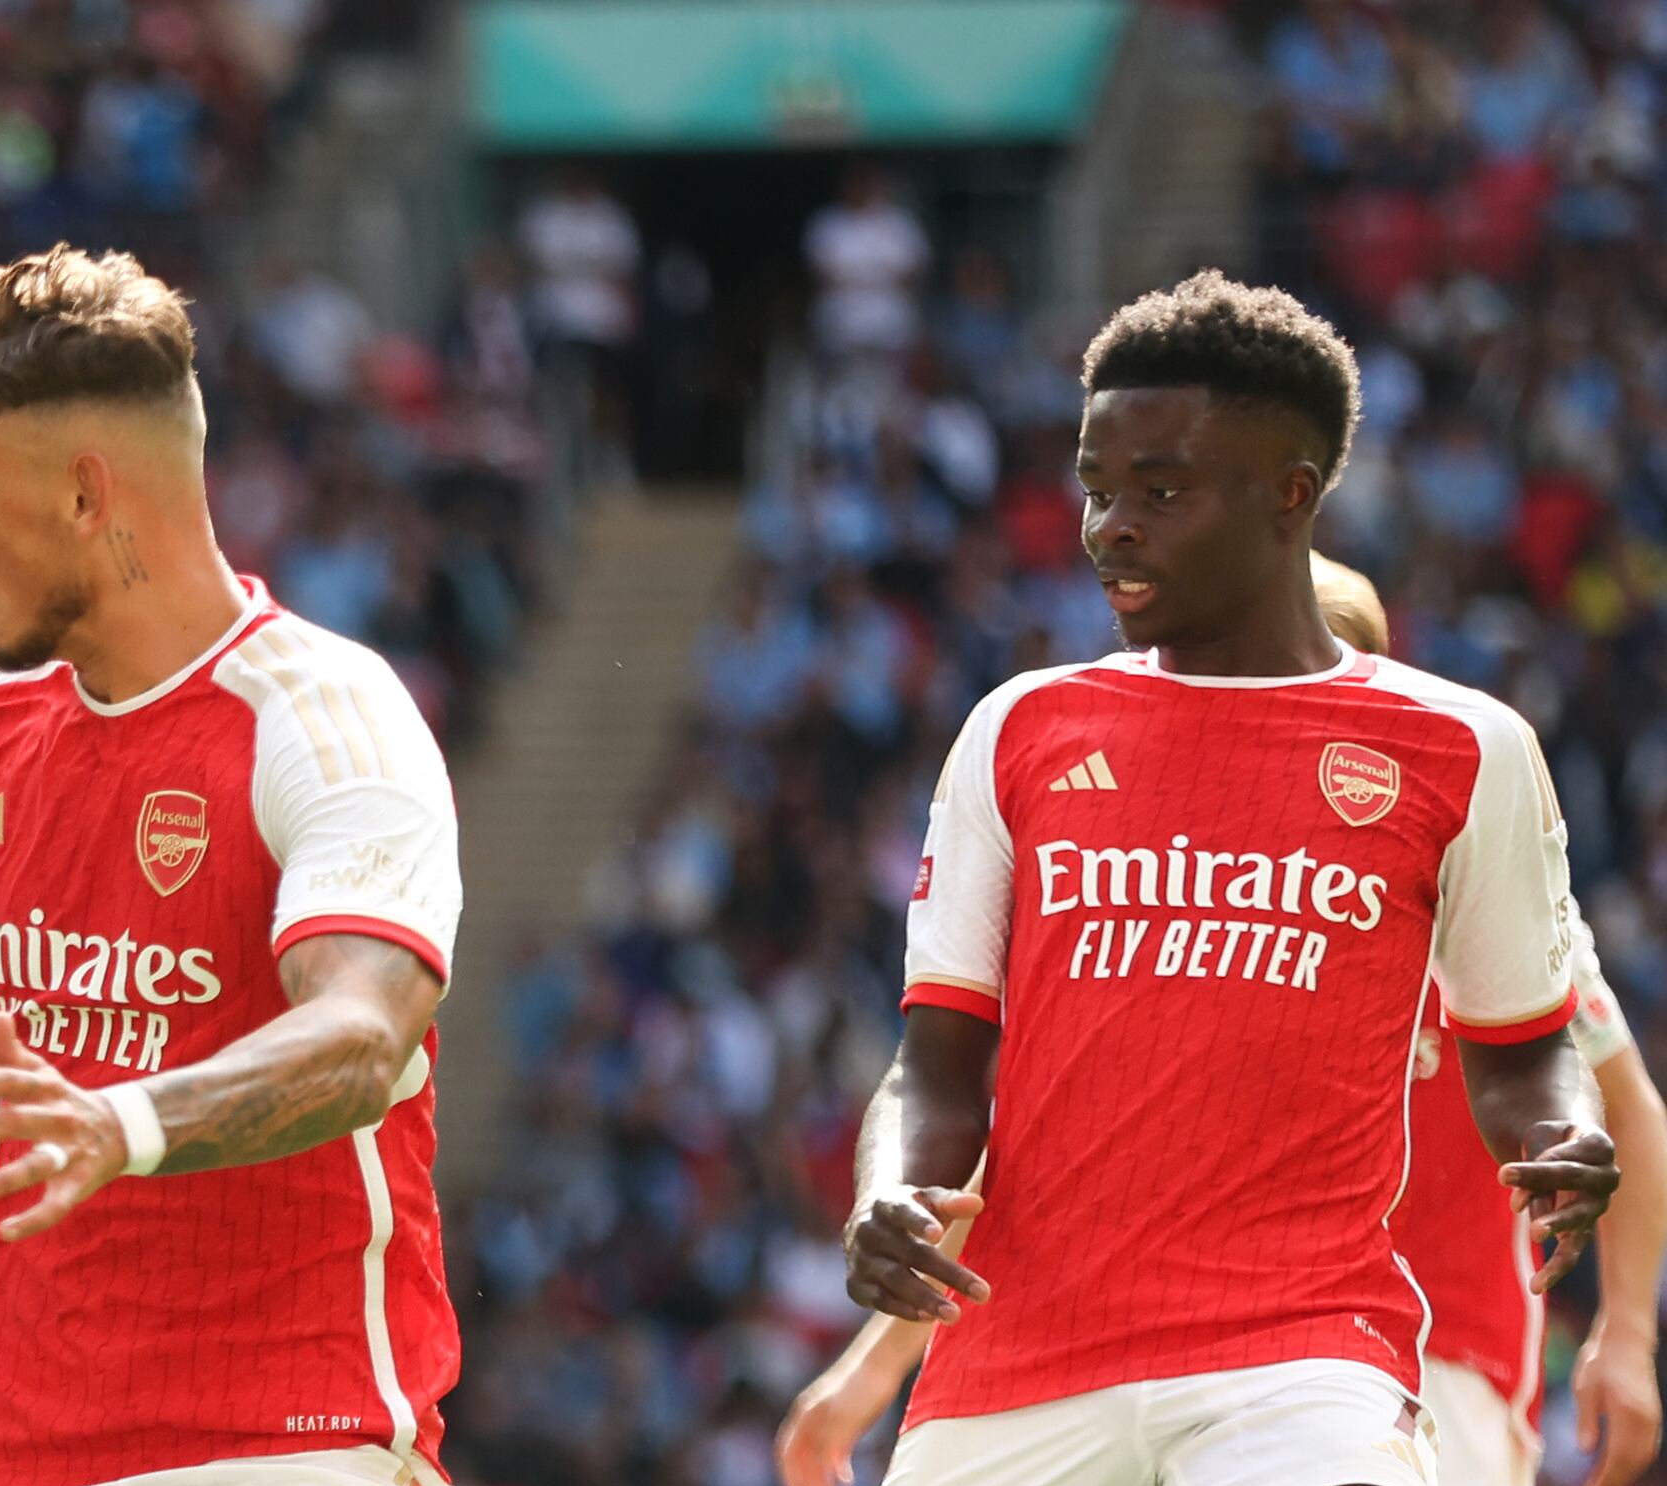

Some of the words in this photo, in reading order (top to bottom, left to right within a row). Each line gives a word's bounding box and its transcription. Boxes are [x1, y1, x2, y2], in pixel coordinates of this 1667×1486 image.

[1333, 754, 1389, 780] Arsenal
[150, 807, 202, 829] Arsenal
[1035, 834, 1388, 931] Emirates
[1069, 919, 1151, 980] FLY
[1153, 919, 1328, 992] BETTER
[285, 1415, 362, 1432] HEAT.RDY
